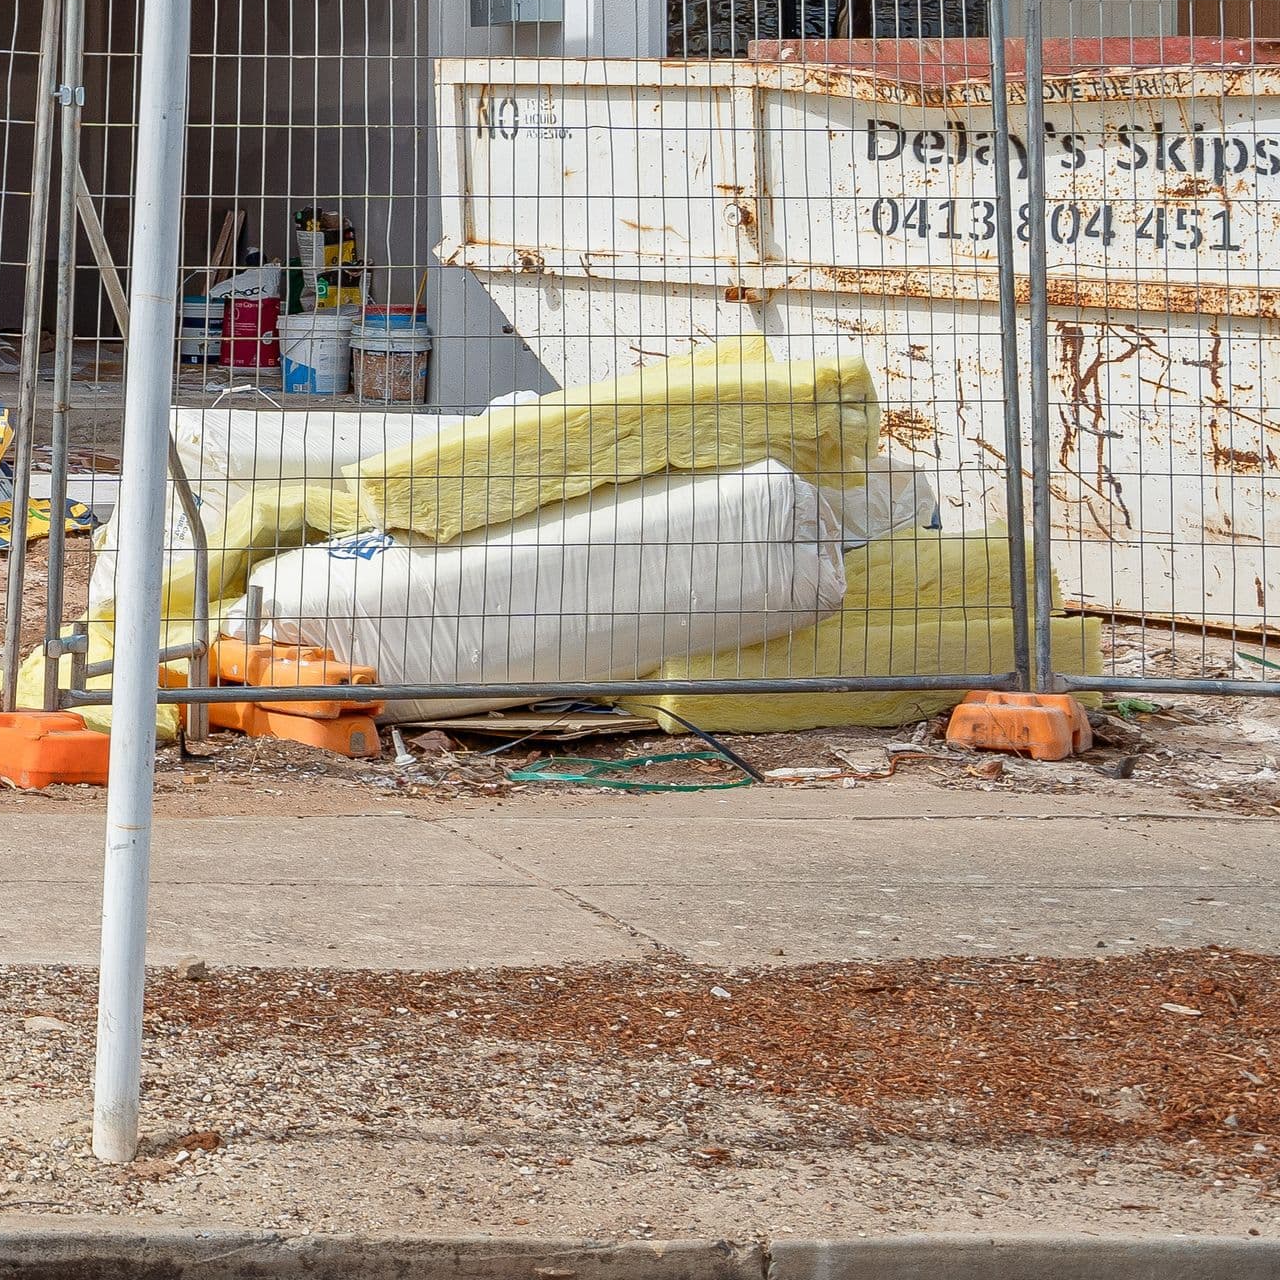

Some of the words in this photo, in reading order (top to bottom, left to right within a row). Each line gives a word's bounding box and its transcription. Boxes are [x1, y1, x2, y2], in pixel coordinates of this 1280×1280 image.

[1117, 121, 1280, 187] Skips
[872, 197, 996, 241] 0413
[1135, 207, 1241, 252] 451
